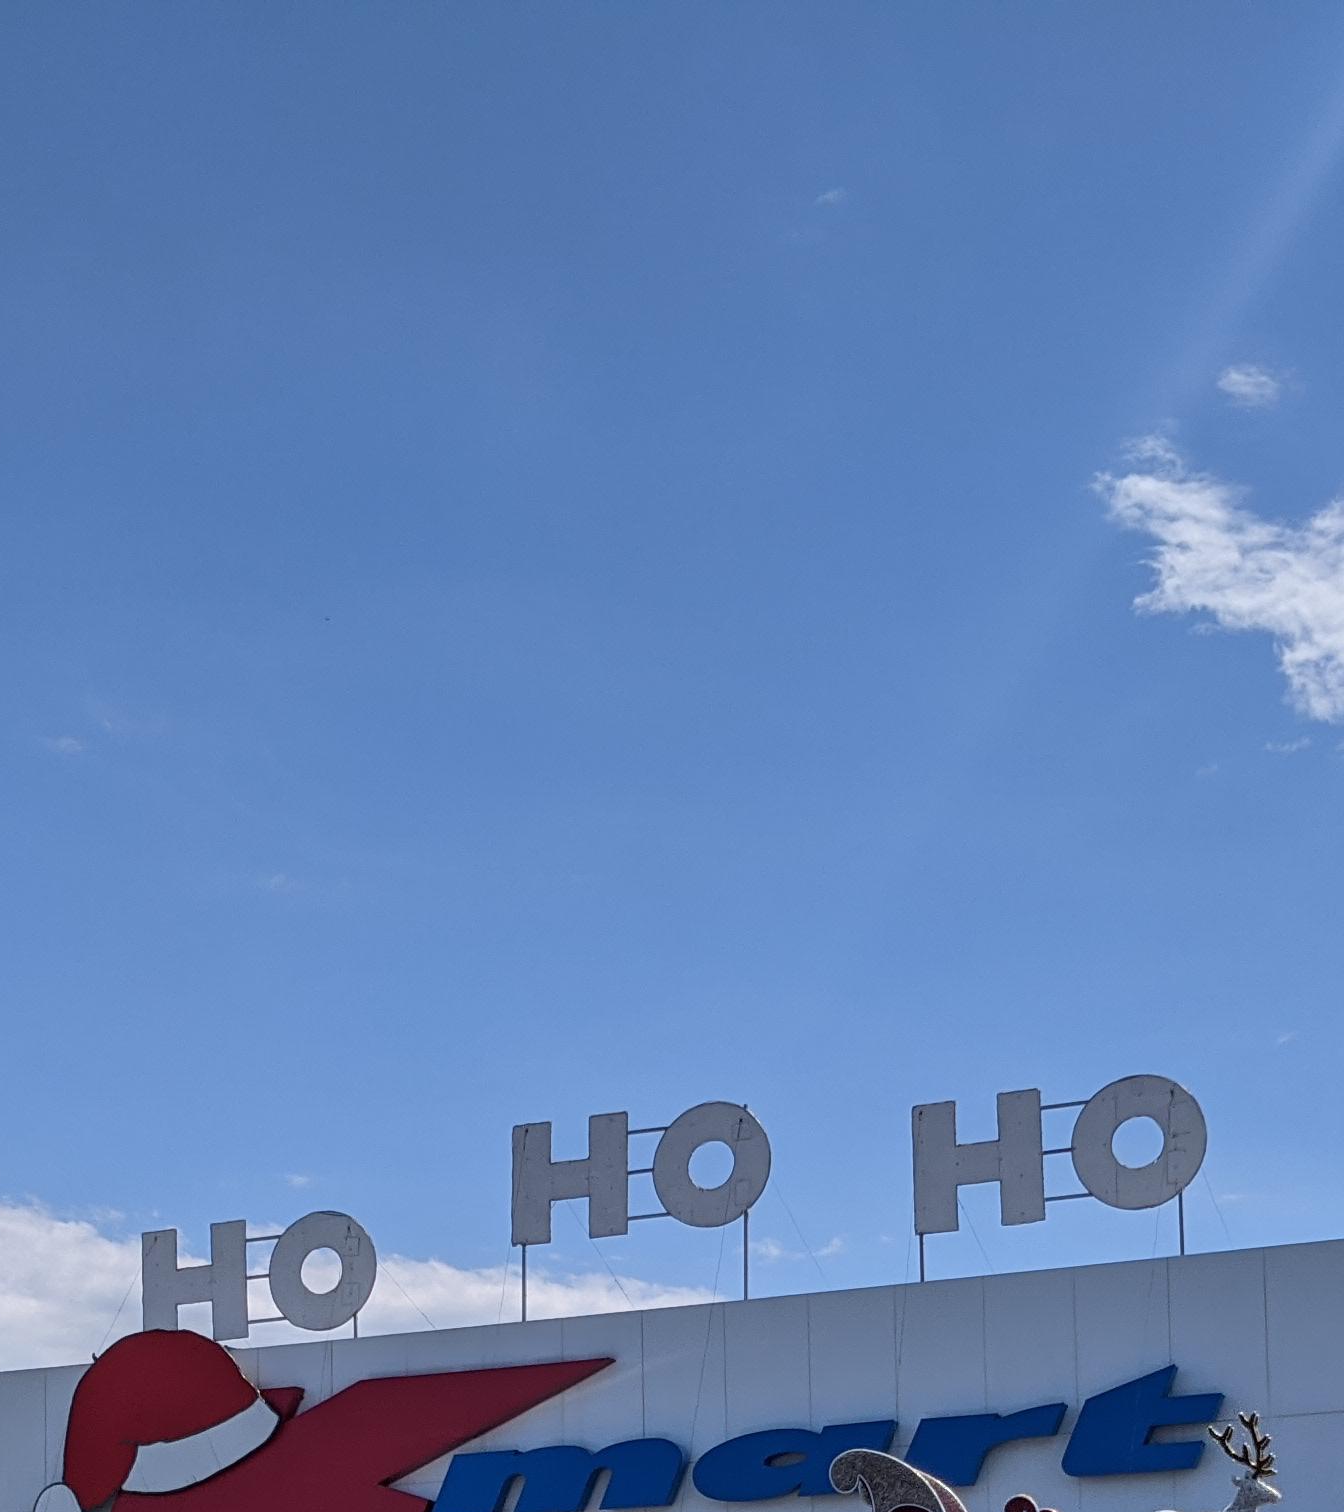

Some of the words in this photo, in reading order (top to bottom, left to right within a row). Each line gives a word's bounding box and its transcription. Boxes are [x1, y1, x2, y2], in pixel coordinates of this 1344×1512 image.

[142, 1211, 377, 1339] HO
[512, 1101, 771, 1247] HO
[912, 1075, 1207, 1235] HO
